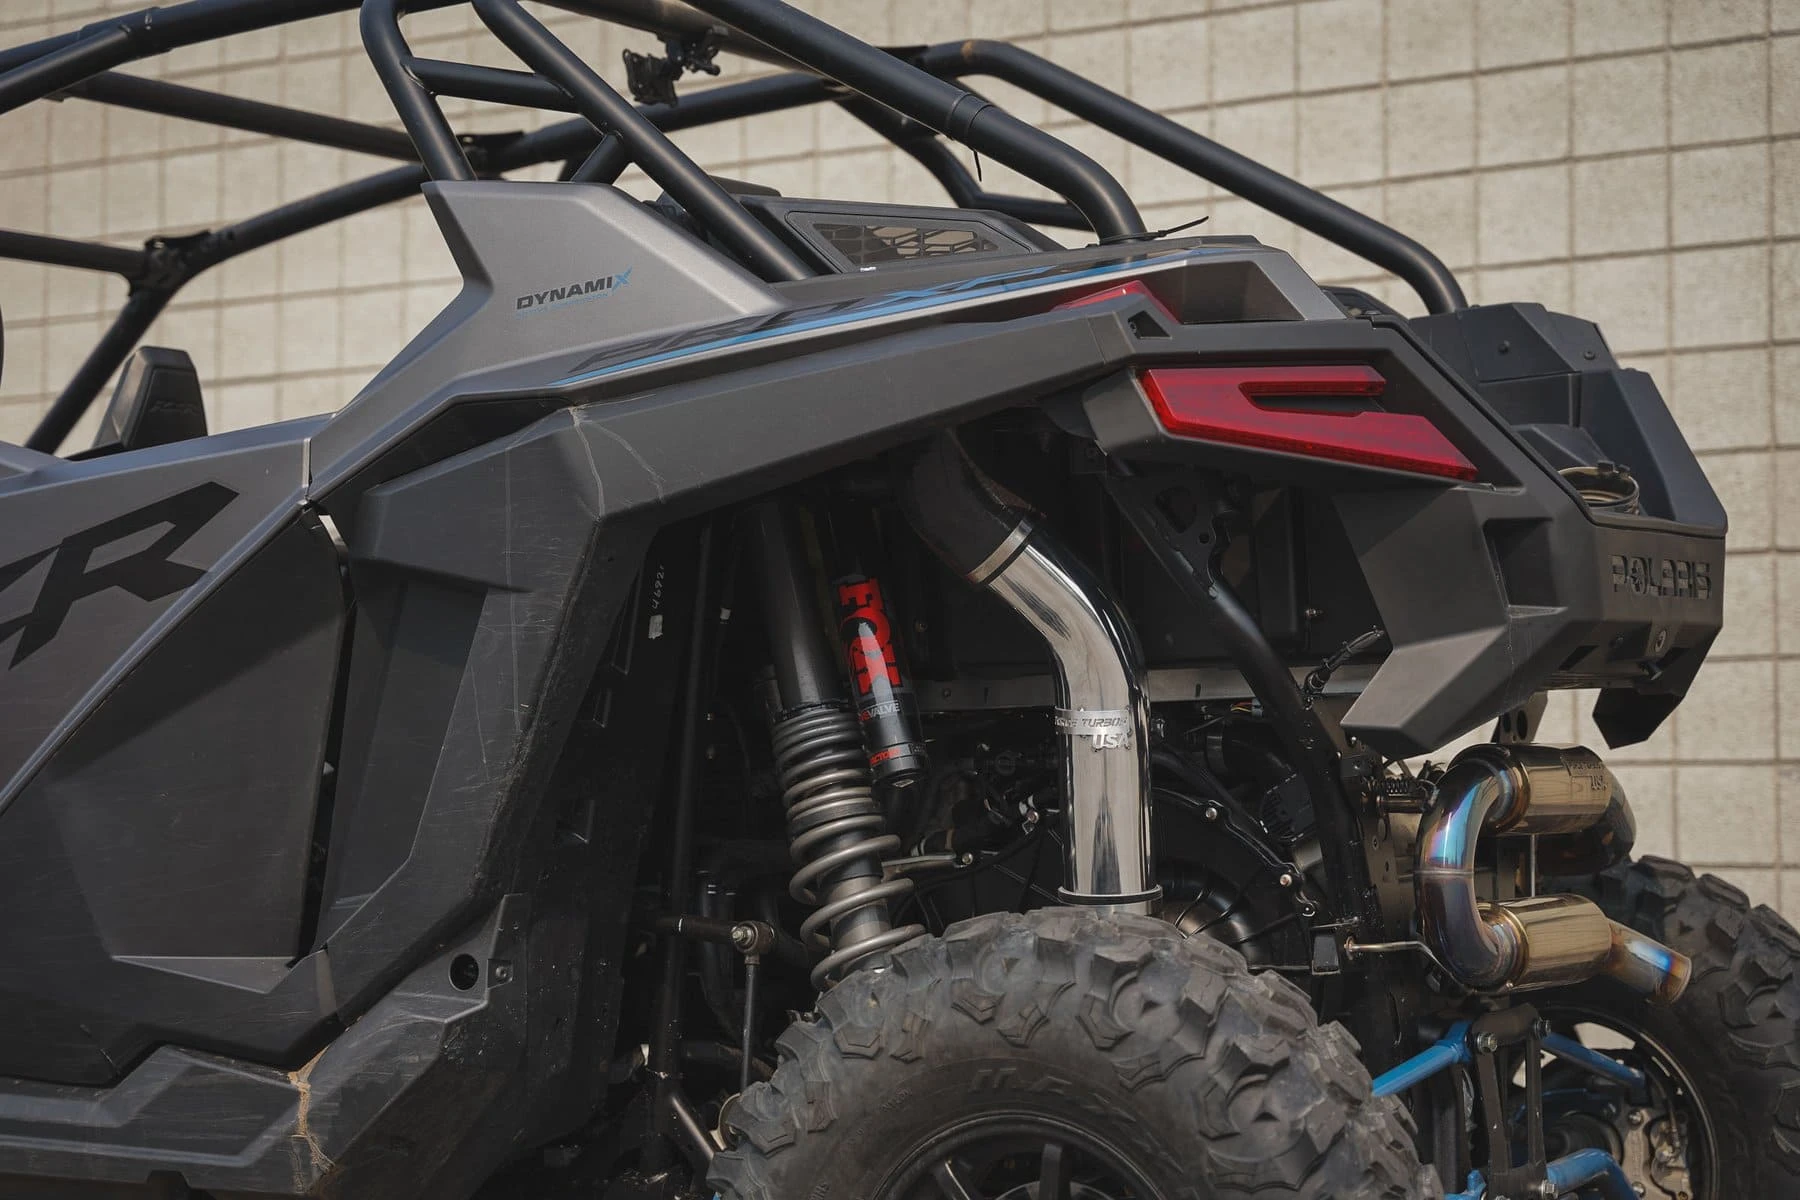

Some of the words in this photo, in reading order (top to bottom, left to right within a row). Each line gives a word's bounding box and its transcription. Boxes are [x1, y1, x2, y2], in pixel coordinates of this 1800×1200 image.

[516, 266, 633, 310] DYNAMIX
[1609, 554, 1712, 599] POLARIS
[1092, 733, 1130, 751] USA
